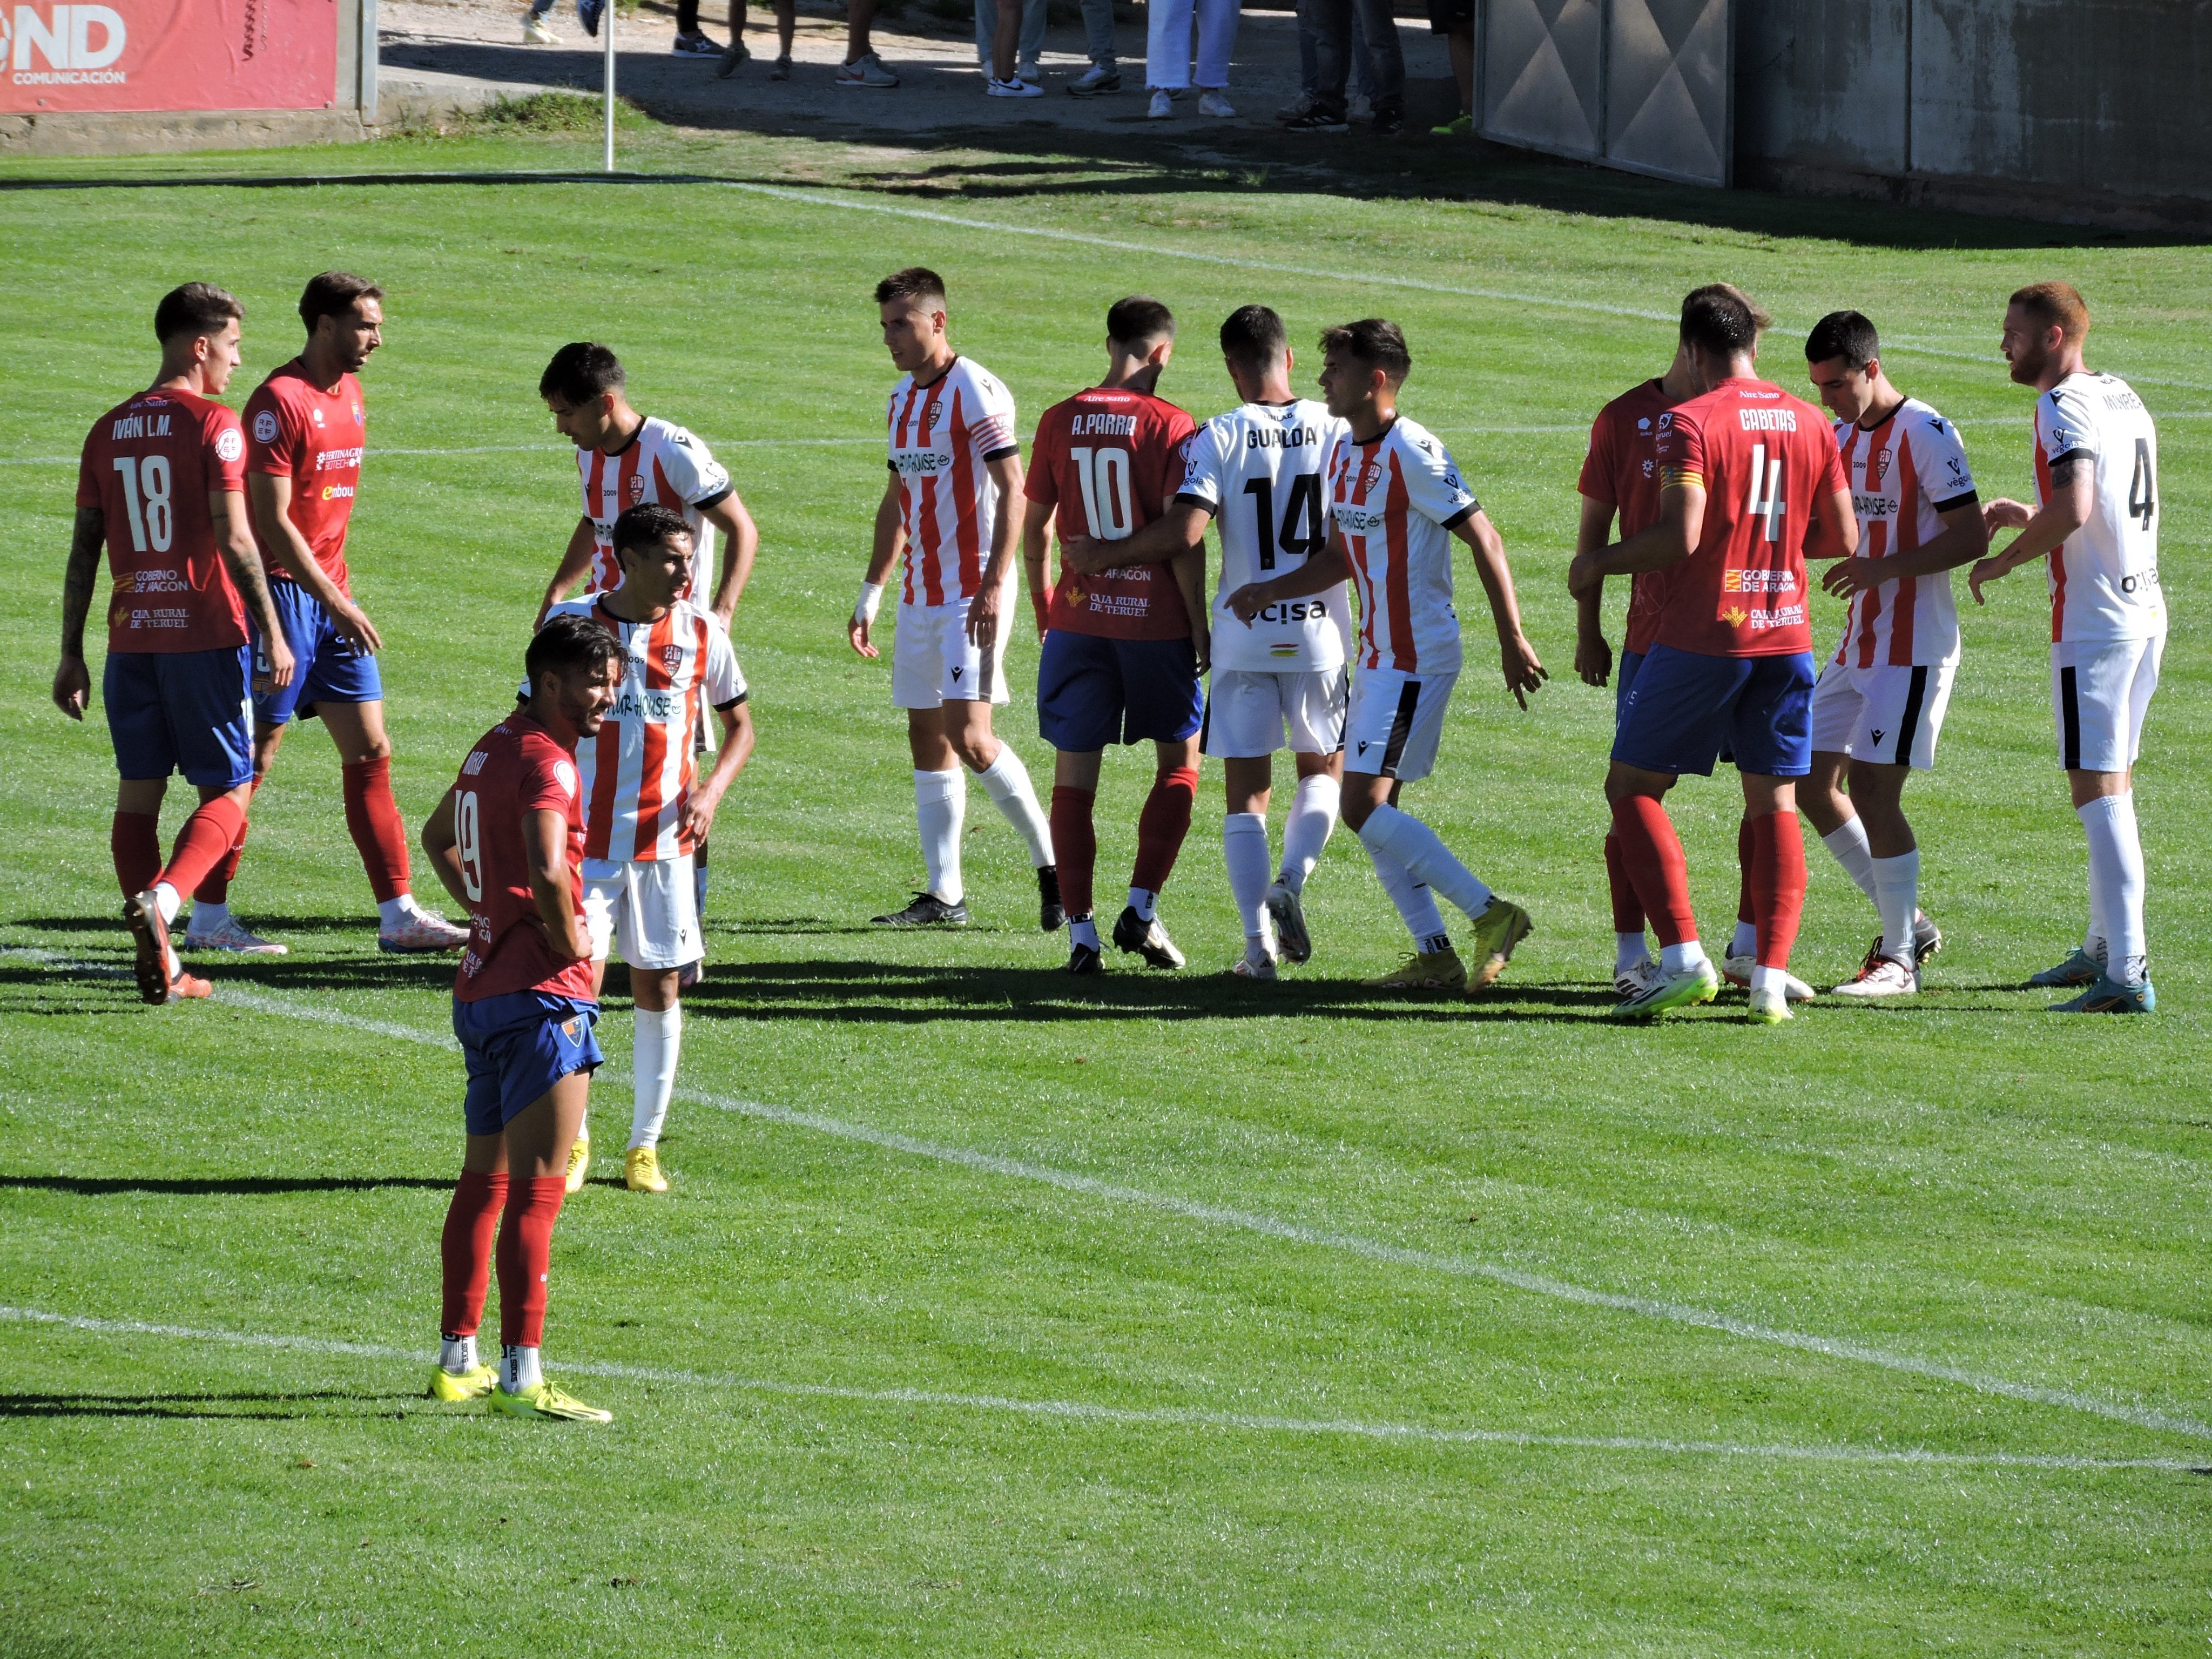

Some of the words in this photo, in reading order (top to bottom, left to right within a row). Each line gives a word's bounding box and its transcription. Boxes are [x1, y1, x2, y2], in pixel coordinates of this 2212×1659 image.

[13, 69, 126, 85] COMUNICACIÓN
[112, 413, 143, 441] IVÁN
[147, 414, 172, 437] L.M.
[1071, 414, 1137, 436] A.PARRA
[1739, 409, 1797, 432] CABETAS
[1247, 427, 1317, 449] GUALDA
[1183, 476, 1204, 486] gola
[2128, 437, 2155, 532] 4
[321, 483, 354, 501] embou
[1070, 447, 1133, 541] 10
[1749, 444, 1786, 542] 4
[113, 455, 172, 552] 18
[1243, 473, 1326, 571] 14
[135, 582, 146, 593] DE
[1742, 581, 1759, 592] DE
[1089, 602, 1103, 612] DE
[1104, 605, 1148, 617] TERUEL
[1090, 593, 1112, 605] CAJA
[1116, 596, 1150, 608] RURAL
[153, 608, 190, 618] RURAL
[1751, 609, 1774, 619] CAJA
[1774, 604, 1803, 619] RURAL
[130, 620, 141, 629] DE
[144, 618, 188, 628] TERUEL
[1751, 619, 1765, 629] DE
[1766, 614, 1804, 628] TERUEL
[629, 656, 645, 664] 009
[634, 693, 672, 718] HOUSE
[454, 790, 482, 902] 19
